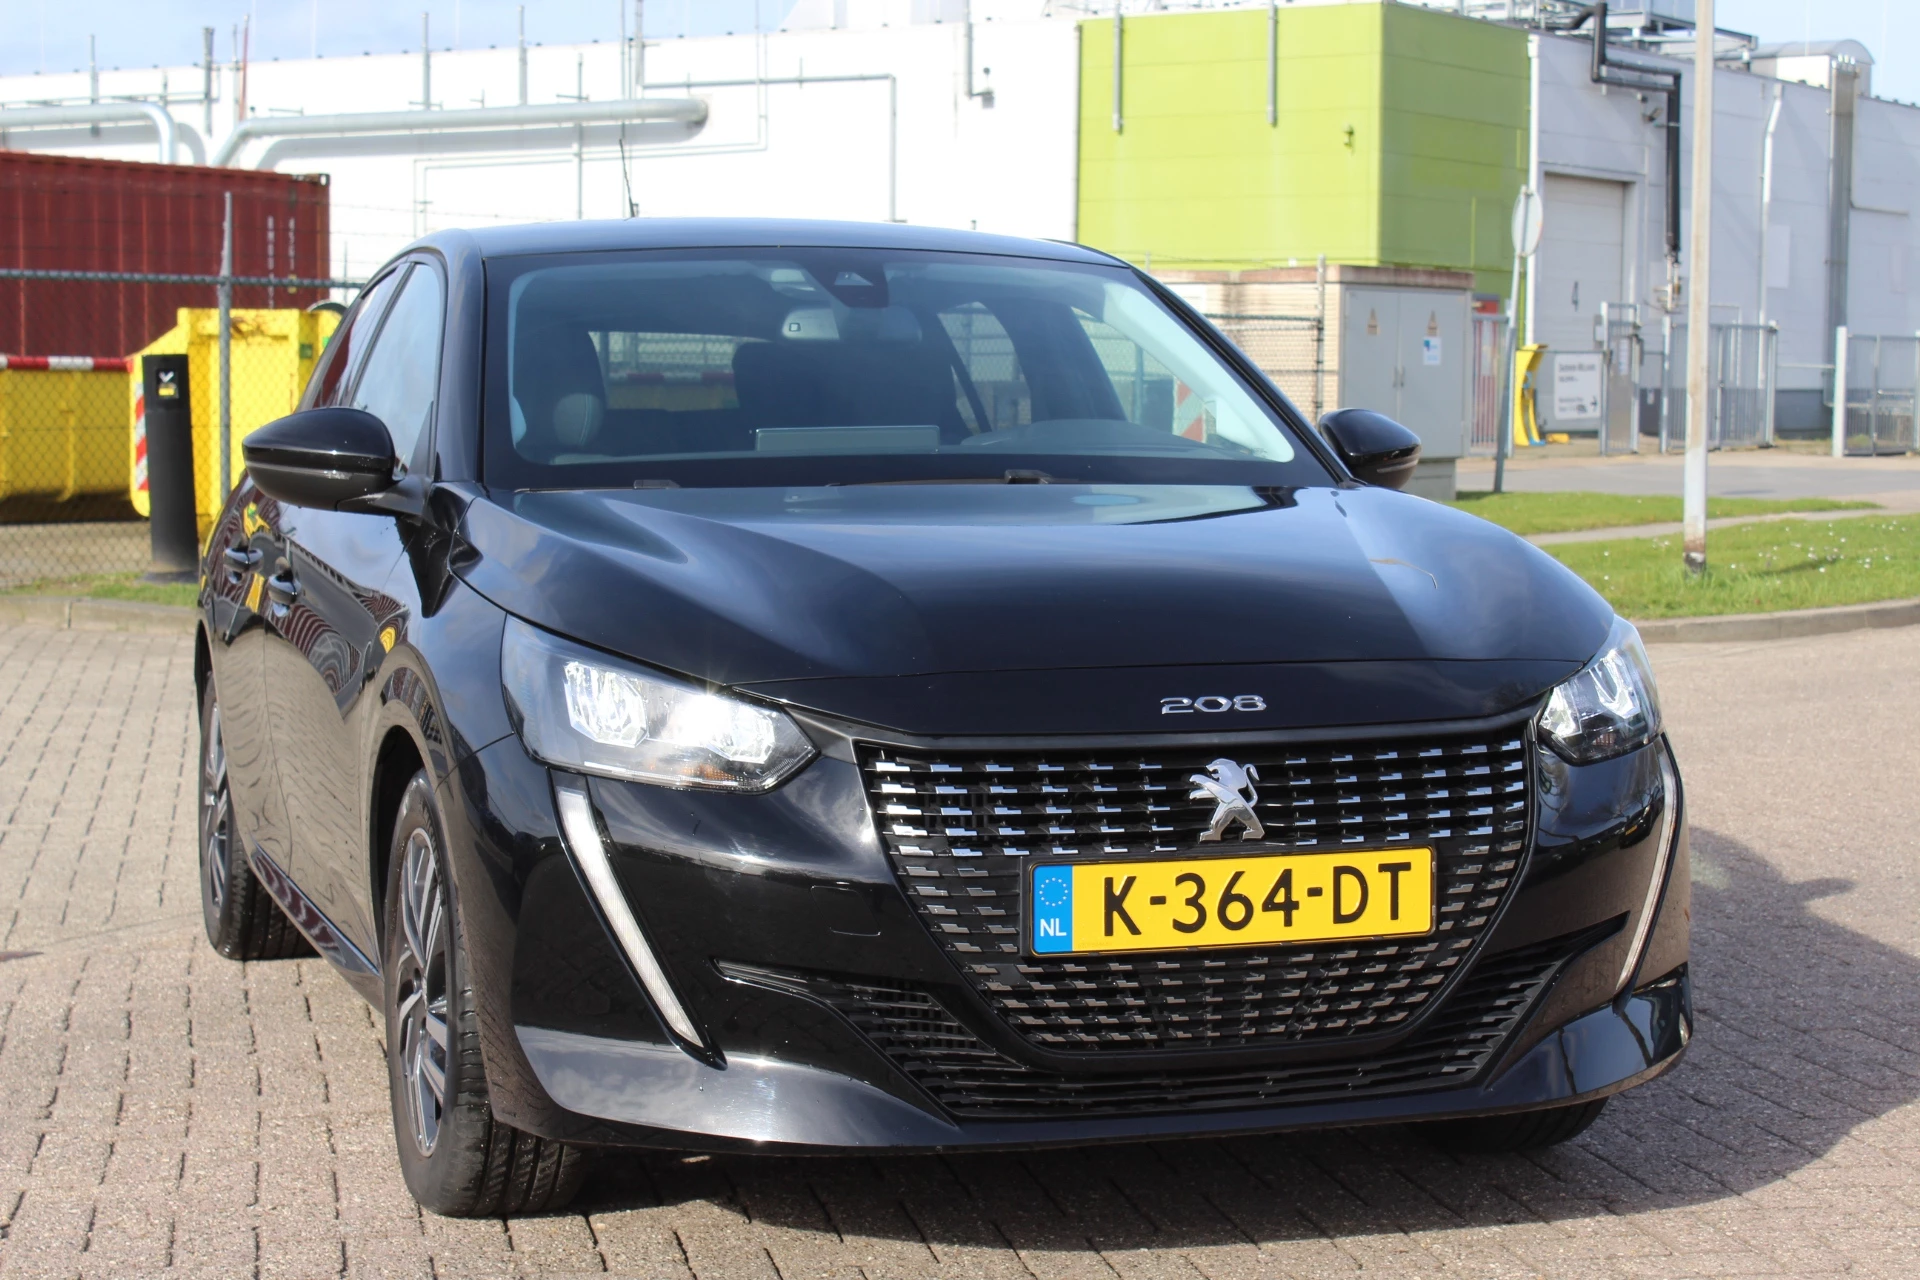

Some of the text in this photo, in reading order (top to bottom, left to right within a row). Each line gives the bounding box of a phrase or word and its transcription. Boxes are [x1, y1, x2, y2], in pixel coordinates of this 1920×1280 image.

[1160, 695, 1267, 714] 208
[1103, 862, 1412, 936] K-364-DT
[1040, 918, 1067, 937] NL
